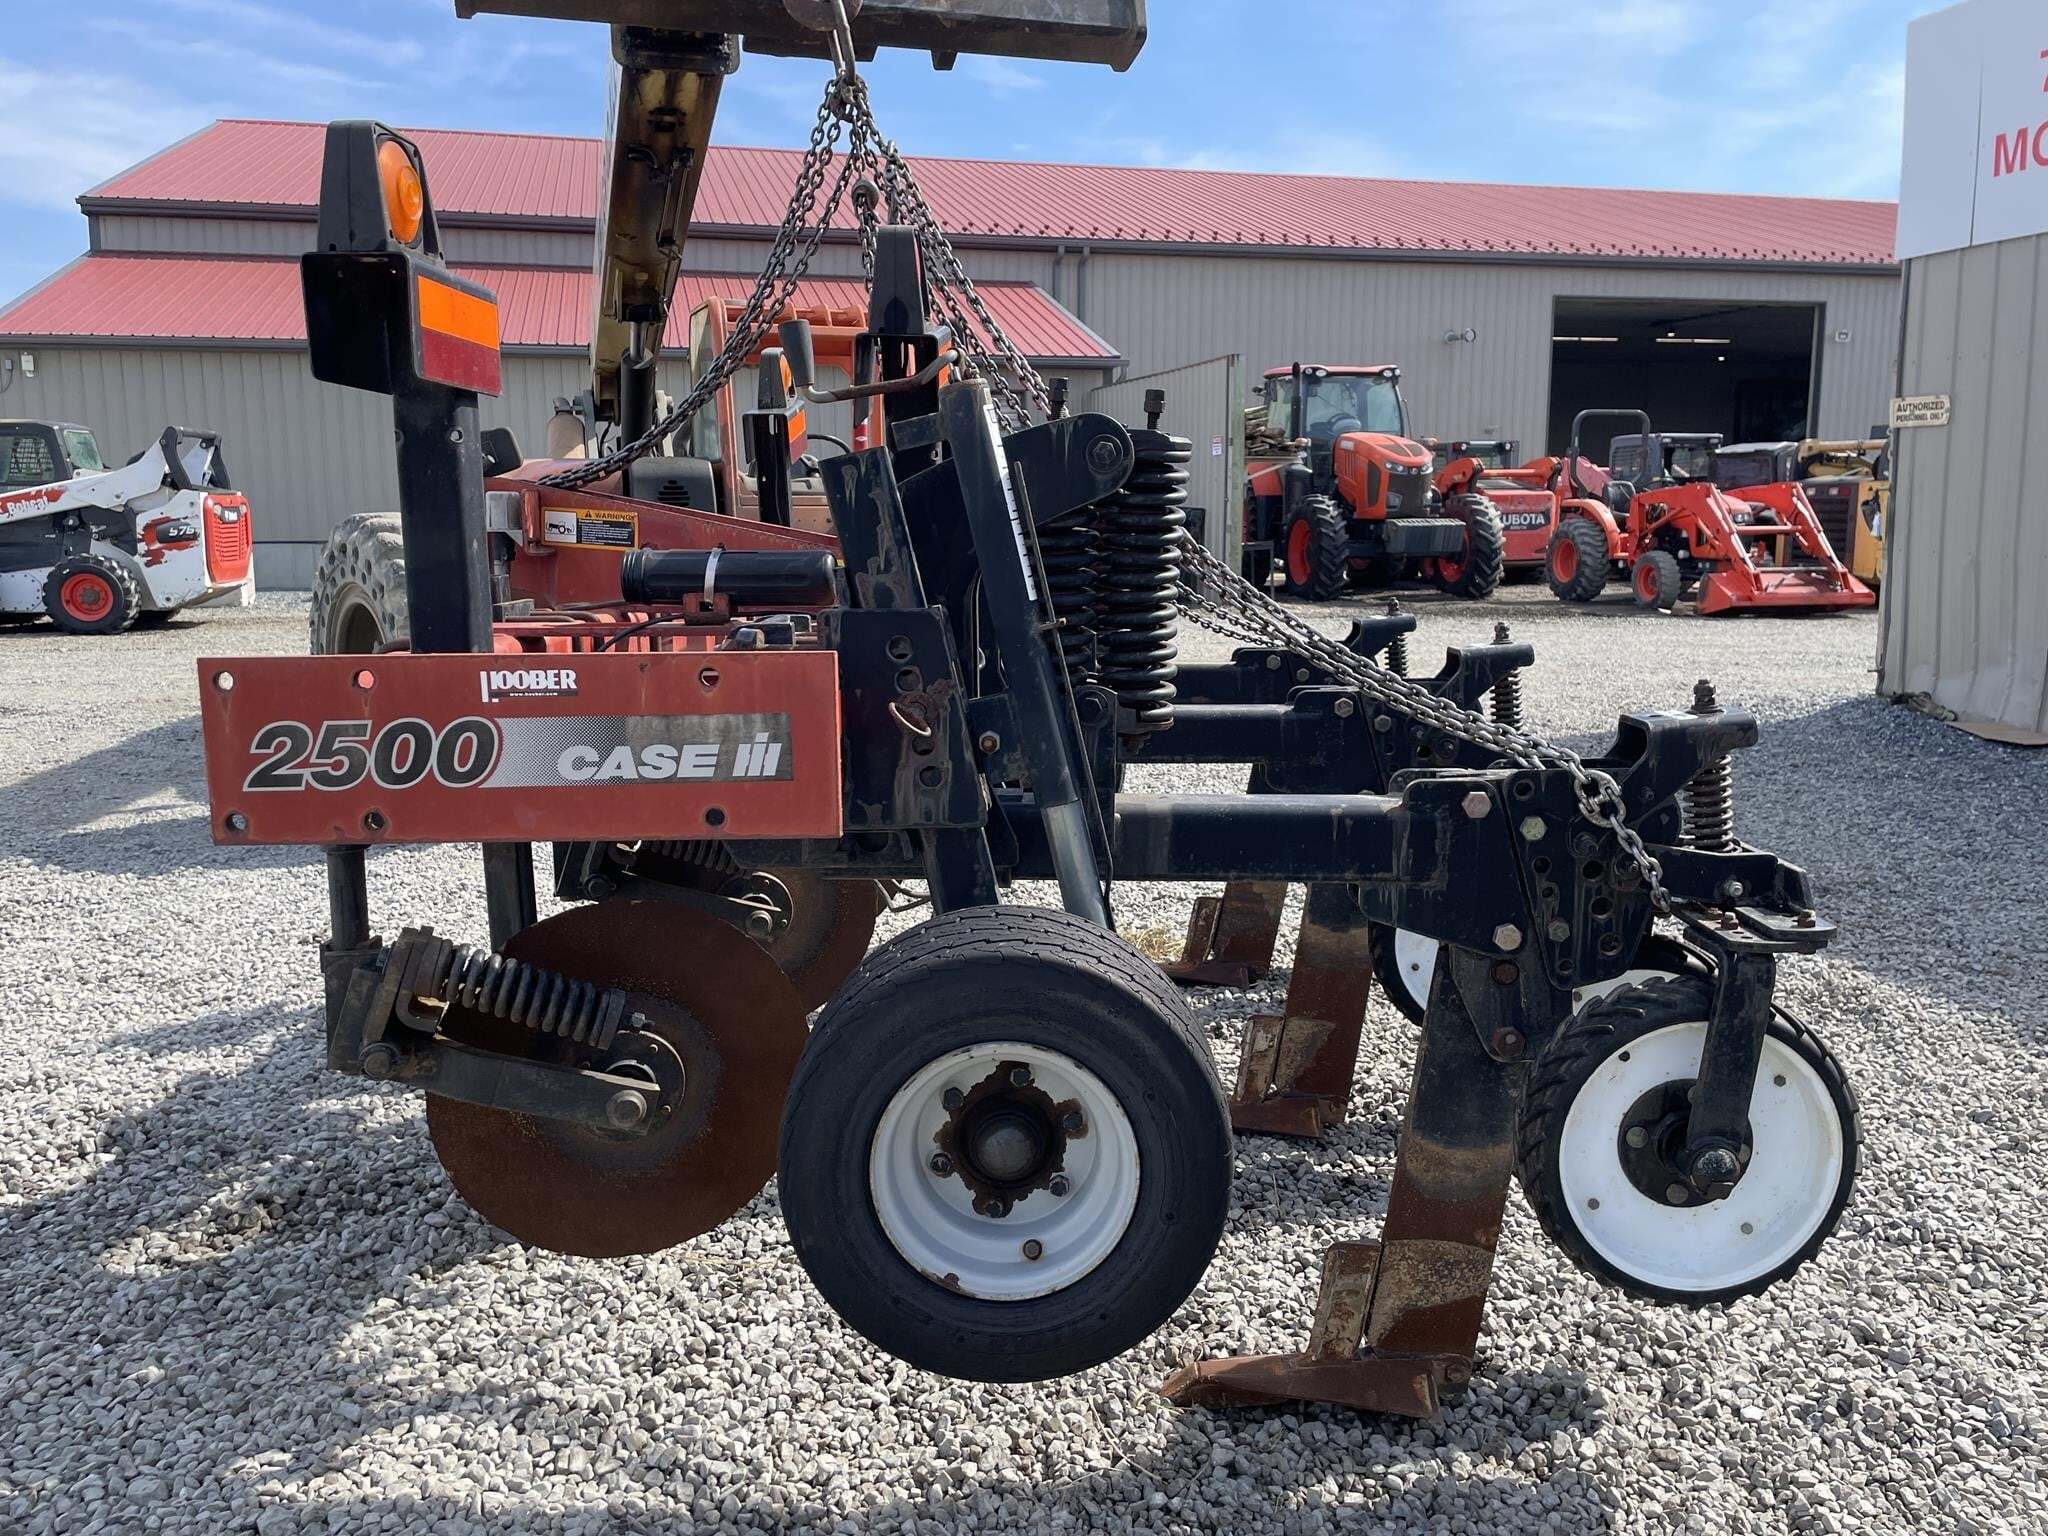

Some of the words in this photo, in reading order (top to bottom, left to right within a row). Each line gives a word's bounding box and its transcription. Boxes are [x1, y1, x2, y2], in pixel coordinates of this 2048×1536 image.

[1897, 401, 1945, 412] AUTHORIZED
[595, 512, 635, 521] WARNING
[1500, 513, 1545, 525] UBOTA
[242, 716, 499, 792] 2500
[556, 743, 720, 780] CASE
